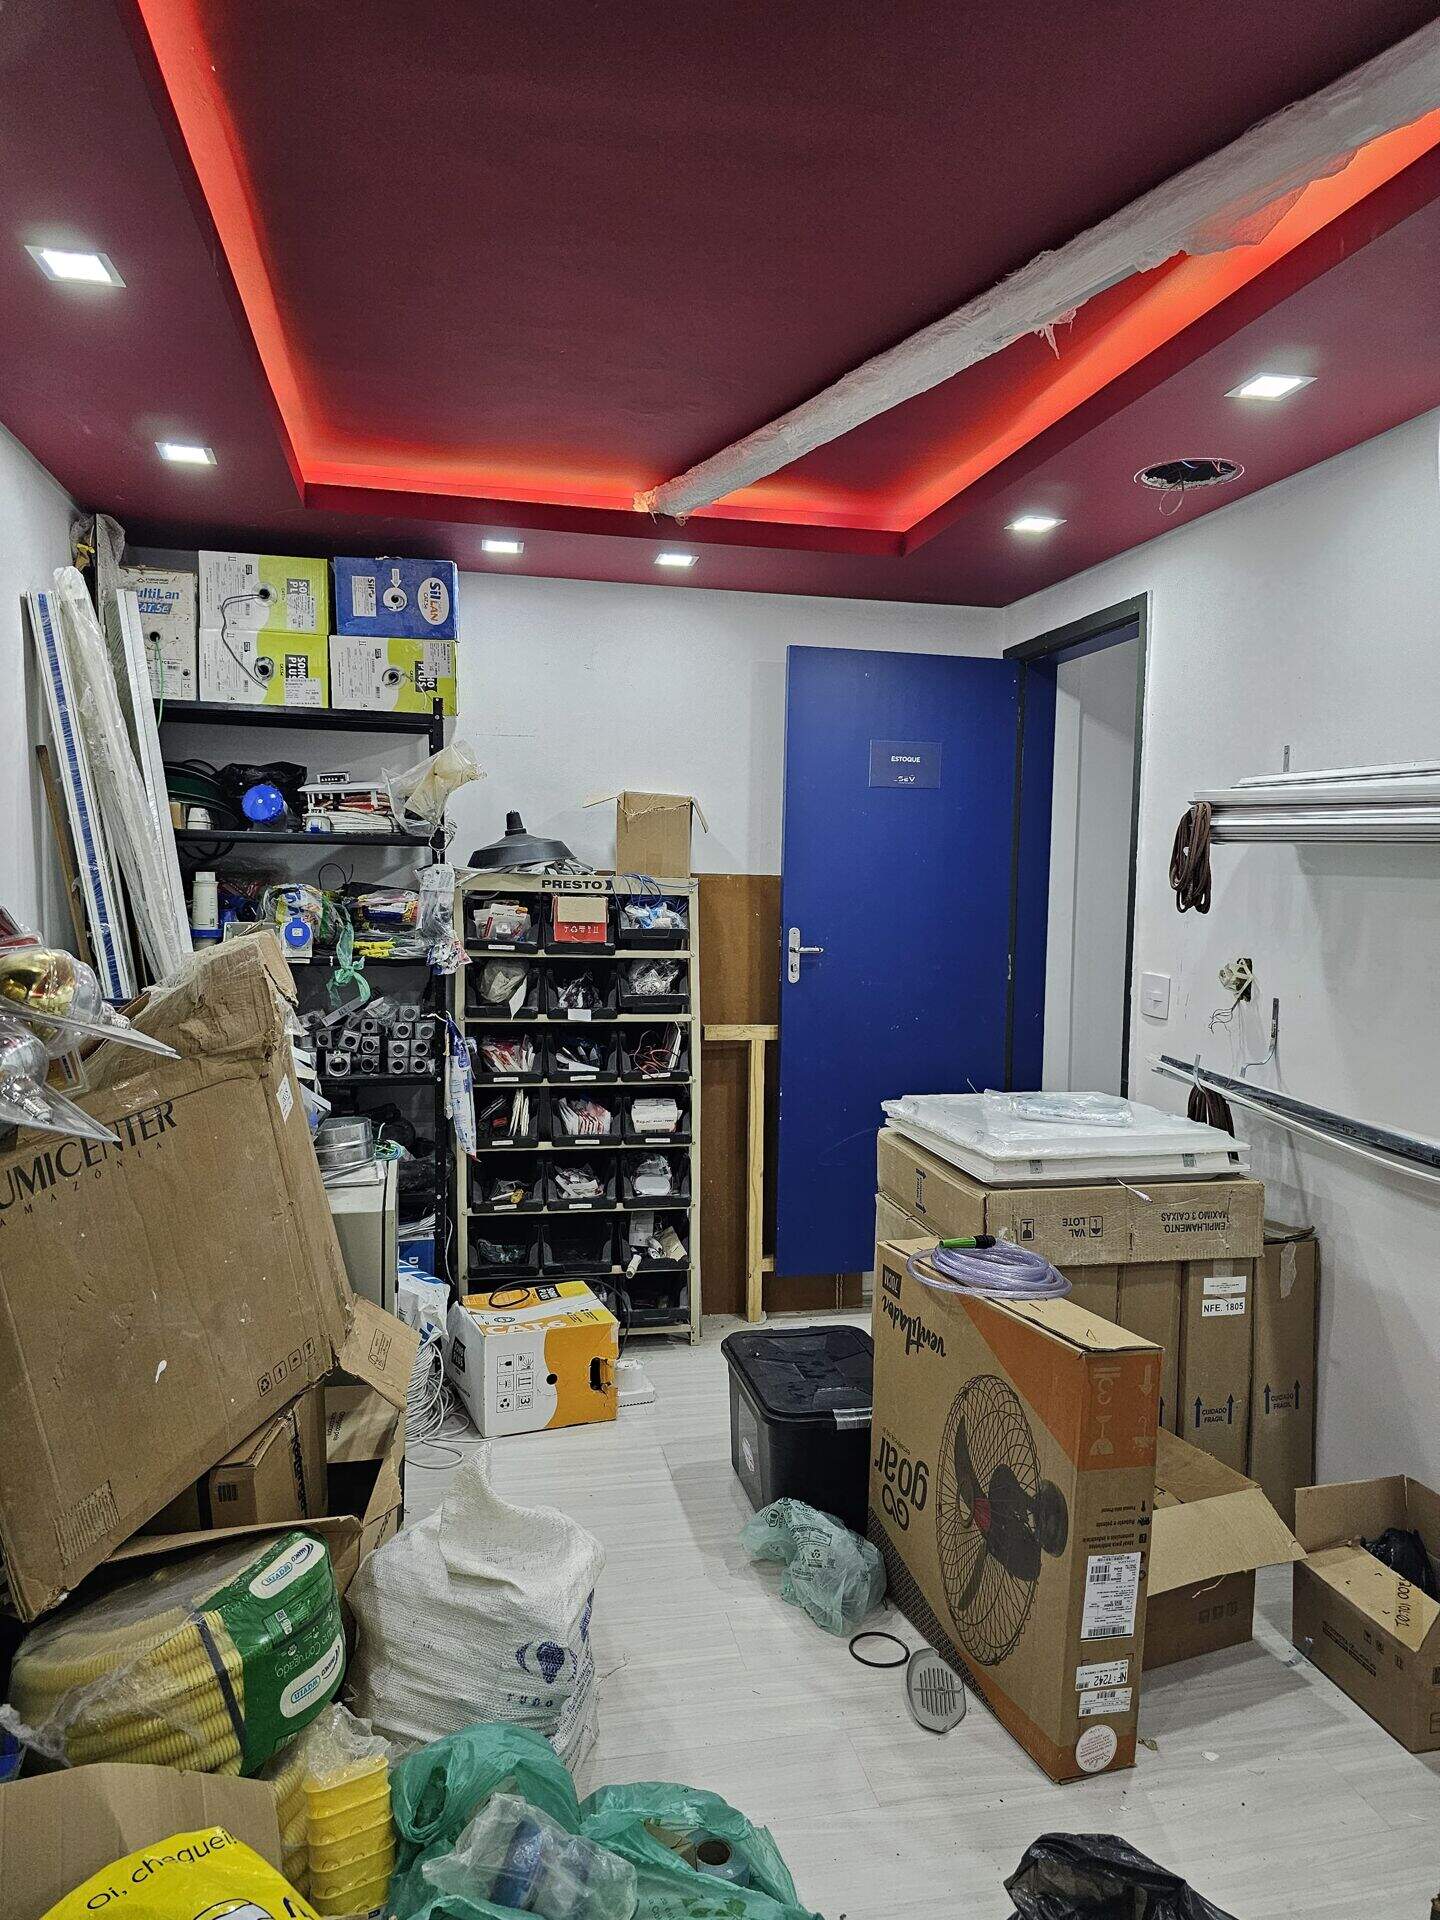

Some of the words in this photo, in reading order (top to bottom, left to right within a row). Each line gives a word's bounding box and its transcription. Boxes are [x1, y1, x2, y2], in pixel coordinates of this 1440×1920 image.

[137, 587, 180, 600] ultiLan
[138, 603, 169, 613] AT.5e
[890, 755, 921, 763] ESTOQUE
[541, 879, 603, 890] PRESTO
[0, 1100, 178, 1210] UMICENTER
[1191, 1211, 1197, 1220] 3
[1062, 1217, 1086, 1227] LOTE
[1068, 1229, 1086, 1238] VAL
[1225, 1302, 1244, 1311] 1805
[1201, 1407, 1228, 1416] CUIDADO
[878, 1436, 930, 1512] goar
